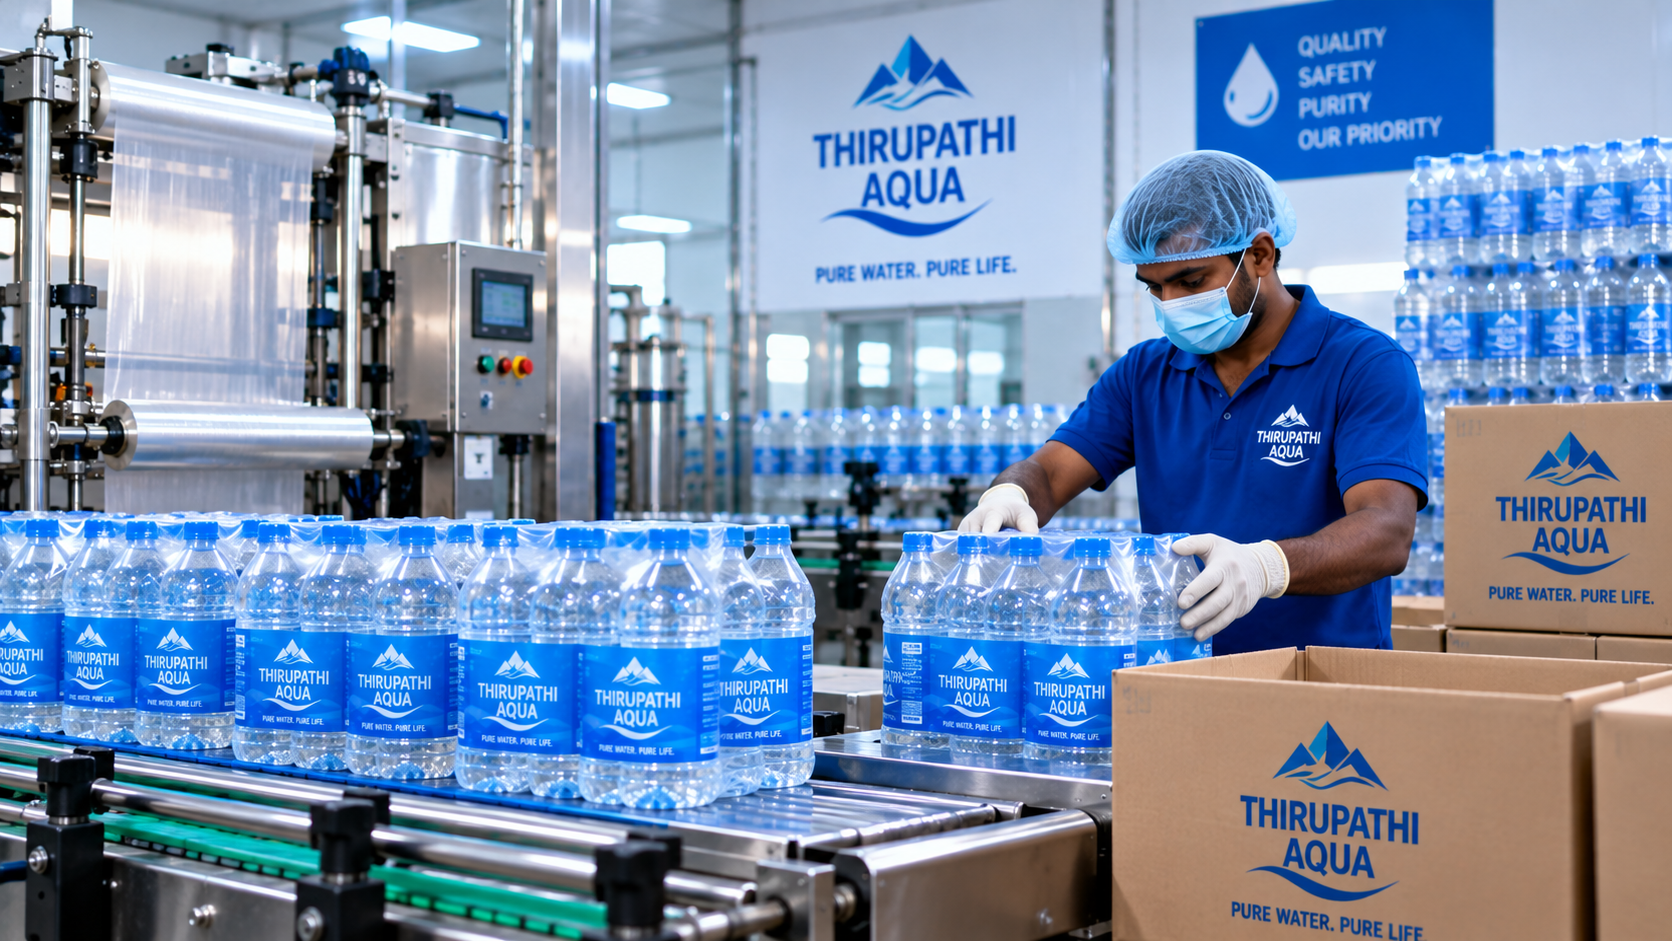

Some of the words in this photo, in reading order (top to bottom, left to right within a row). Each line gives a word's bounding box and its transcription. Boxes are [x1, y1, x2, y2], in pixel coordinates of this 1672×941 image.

[1298, 26, 1387, 58] QUALITY
[1298, 59, 1377, 88] SAFETY
[1298, 91, 1372, 120] PURITY
[813, 115, 1016, 169] THIRUPATHI
[1298, 127, 1342, 151] OUR
[1346, 115, 1443, 146] PRIORITY
[861, 166, 966, 210] AQUA
[815, 265, 856, 284] PURE
[861, 261, 921, 281] WATER.
[926, 258, 970, 278] PURE
[976, 255, 1017, 275] LIFE.
[1257, 430, 1321, 444] THIRUPATHI
[1269, 444, 1303, 459] AQUA
[1495, 496, 1647, 523] THIRUPATHI
[1532, 527, 1610, 556] AQUA
[1488, 586, 1523, 600] PURE
[1527, 587, 1577, 602] WATER.
[1581, 588, 1617, 603] PURE
[1621, 590, 1655, 605] LIFE.
[66, 651, 119, 666] THIRUPATHI
[144, 655, 208, 670] THIRUPATHI
[76, 666, 104, 680] AQUA
[157, 670, 191, 685] AQUA
[258, 668, 330, 685] THIRUPATHI
[357, 674, 432, 690] THIRUPATHI
[274, 685, 311, 701] AQUA
[477, 682, 558, 702] THIRUPATHI
[720, 678, 789, 697] THIRUPATHI
[938, 674, 1008, 693] THIRUPATHI
[1033, 681, 1106, 700] THIRUPATHI
[373, 691, 413, 707] AQUA
[594, 689, 681, 709] THIRUPATHI
[733, 696, 771, 714] AQUA
[954, 691, 991, 708] AQUA
[1049, 699, 1088, 716] AQUA
[496, 701, 538, 720] AQUA
[613, 708, 659, 728] AQUA
[1240, 794, 1419, 845] THIRUPATHI
[1282, 837, 1375, 879] AQUA
[1231, 901, 1271, 922] PURE
[1276, 907, 1335, 932] WATER.
[1340, 916, 1383, 939] PURE
